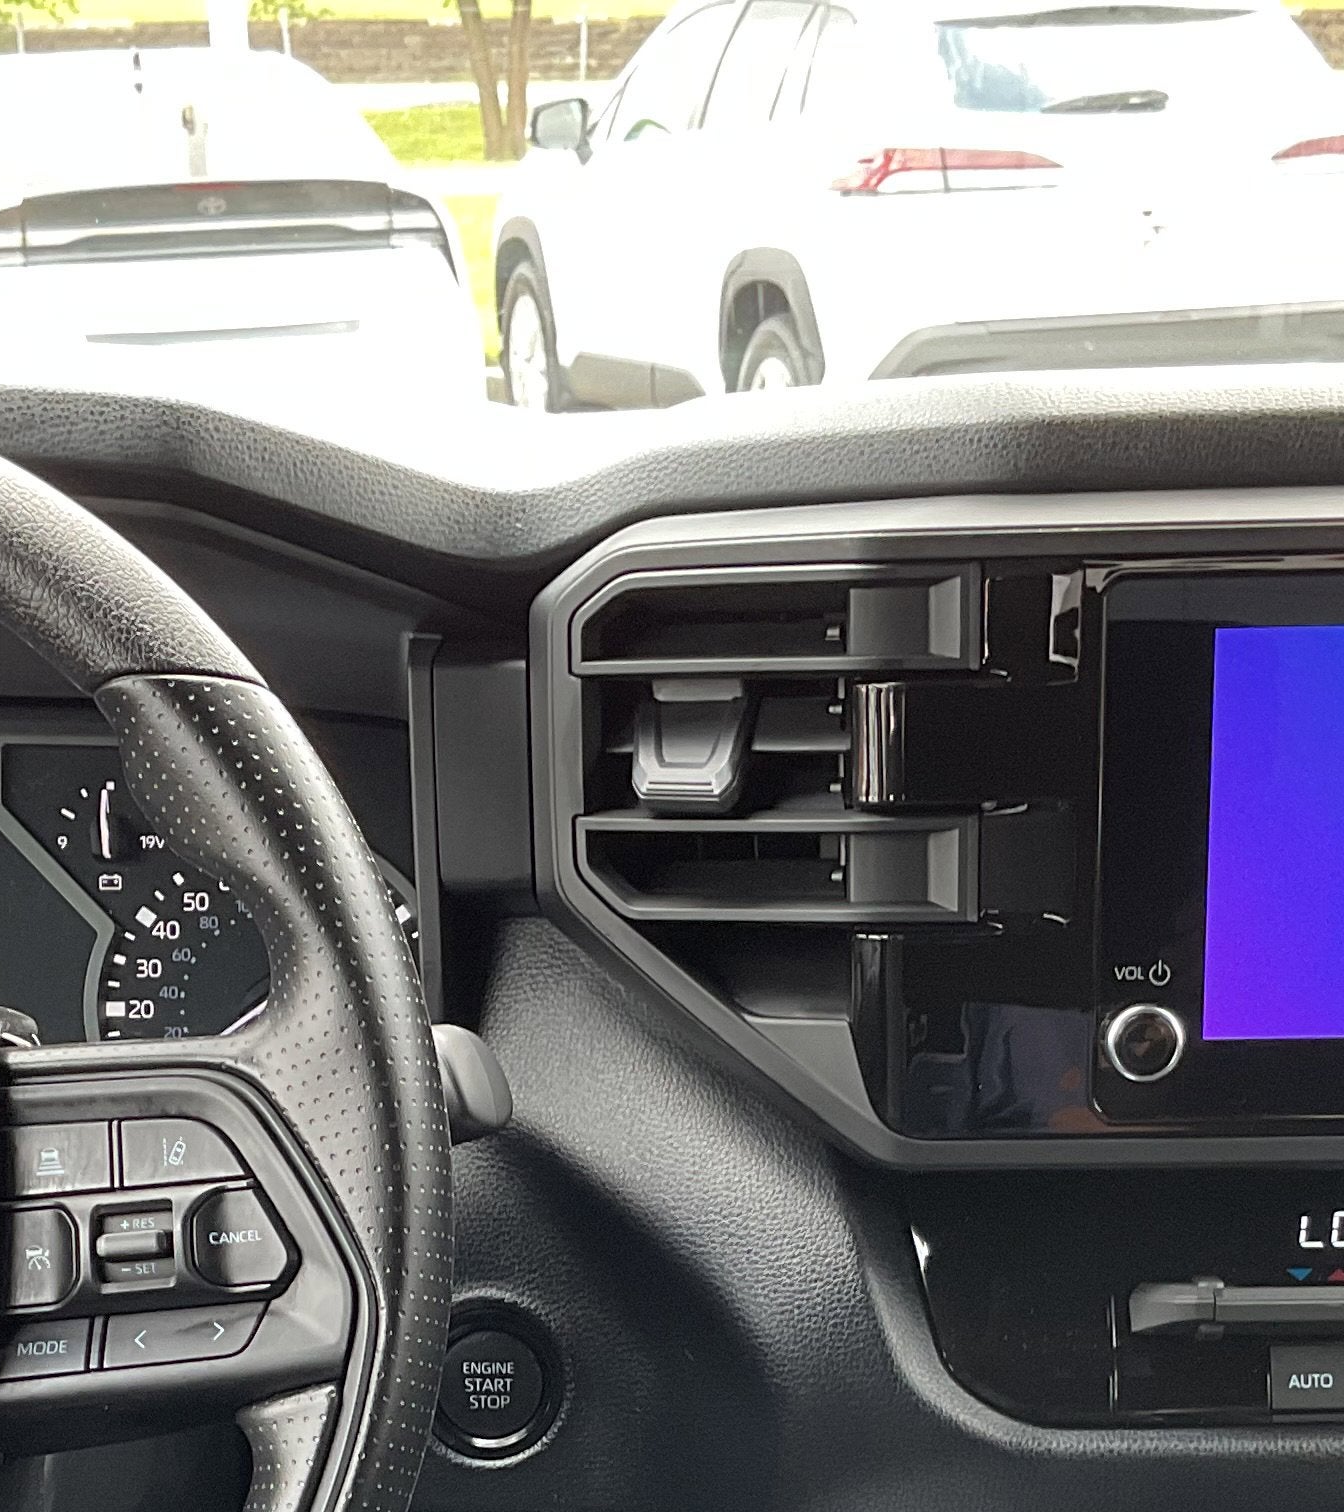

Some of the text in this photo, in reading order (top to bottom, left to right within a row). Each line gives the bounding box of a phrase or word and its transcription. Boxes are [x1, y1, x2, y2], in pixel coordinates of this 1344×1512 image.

[57, 836, 68, 850] 9
[183, 892, 209, 911] 50
[152, 920, 180, 940] 40
[199, 916, 219, 929] 80
[172, 948, 191, 962] 60
[136, 959, 162, 978] 30
[1114, 966, 1145, 981] VOL
[159, 986, 178, 999] 40
[128, 1000, 154, 1019] 20
[209, 1229, 262, 1244] CANCEL
[17, 1339, 68, 1357] MODE
[462, 1361, 515, 1375] ENGINE
[464, 1377, 513, 1393] START
[1288, 1372, 1334, 1390] AUTO
[469, 1394, 511, 1409] STOP
